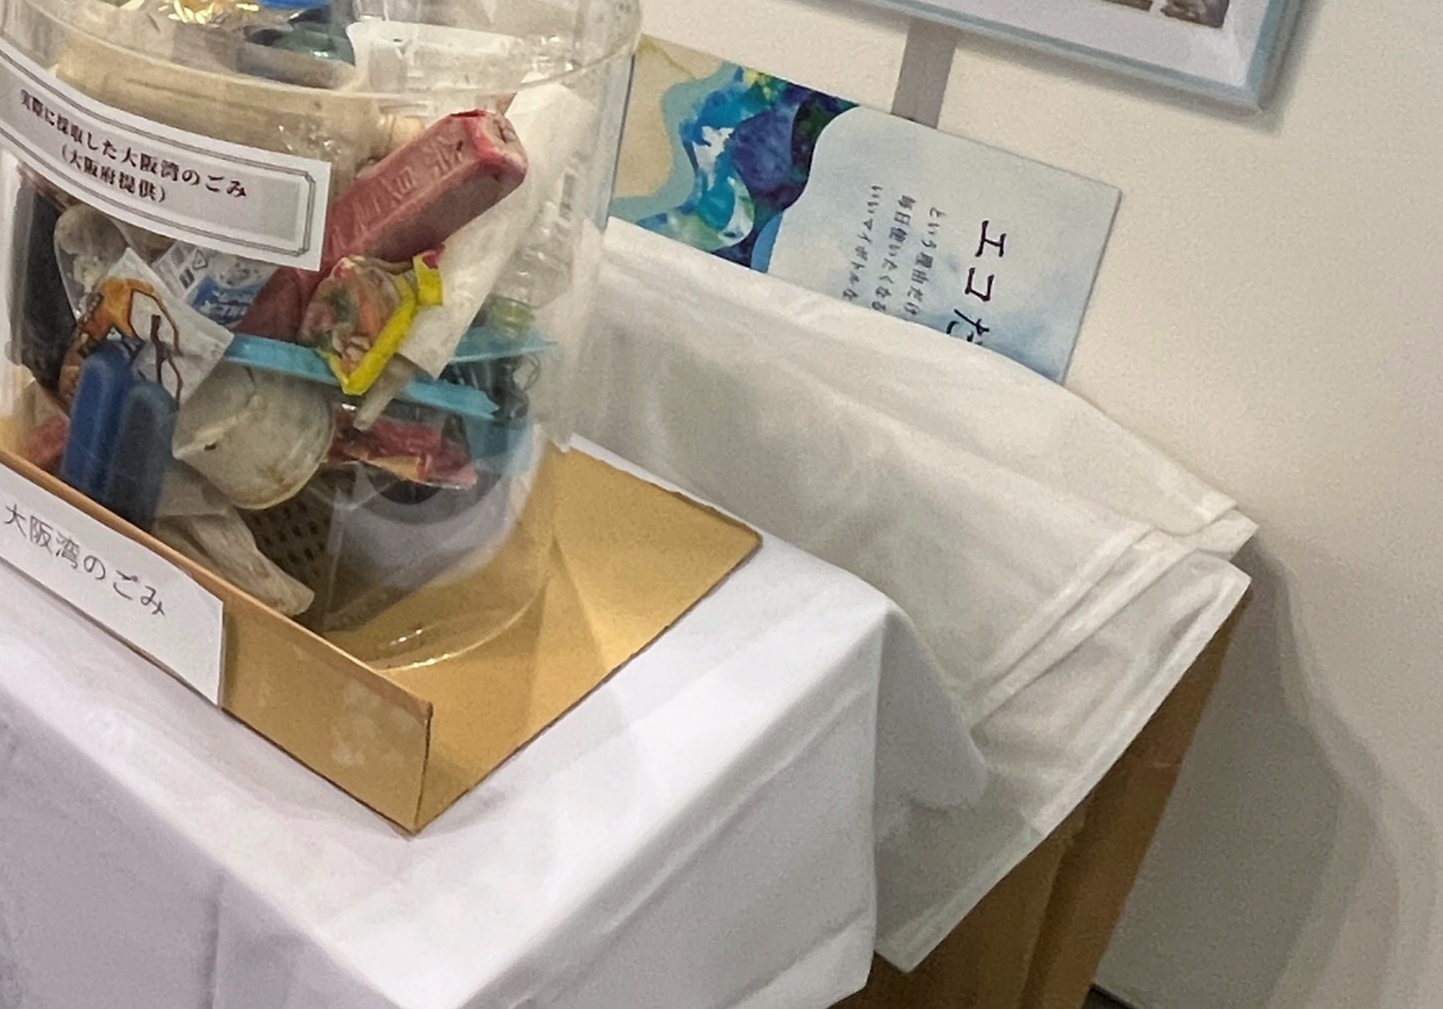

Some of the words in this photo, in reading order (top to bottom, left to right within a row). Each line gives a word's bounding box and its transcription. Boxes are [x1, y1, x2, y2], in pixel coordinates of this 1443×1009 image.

[20, 88, 247, 198] 実際に採取した大阪湾のごみ
[3, 504, 167, 617] 大阪湾のごみ
